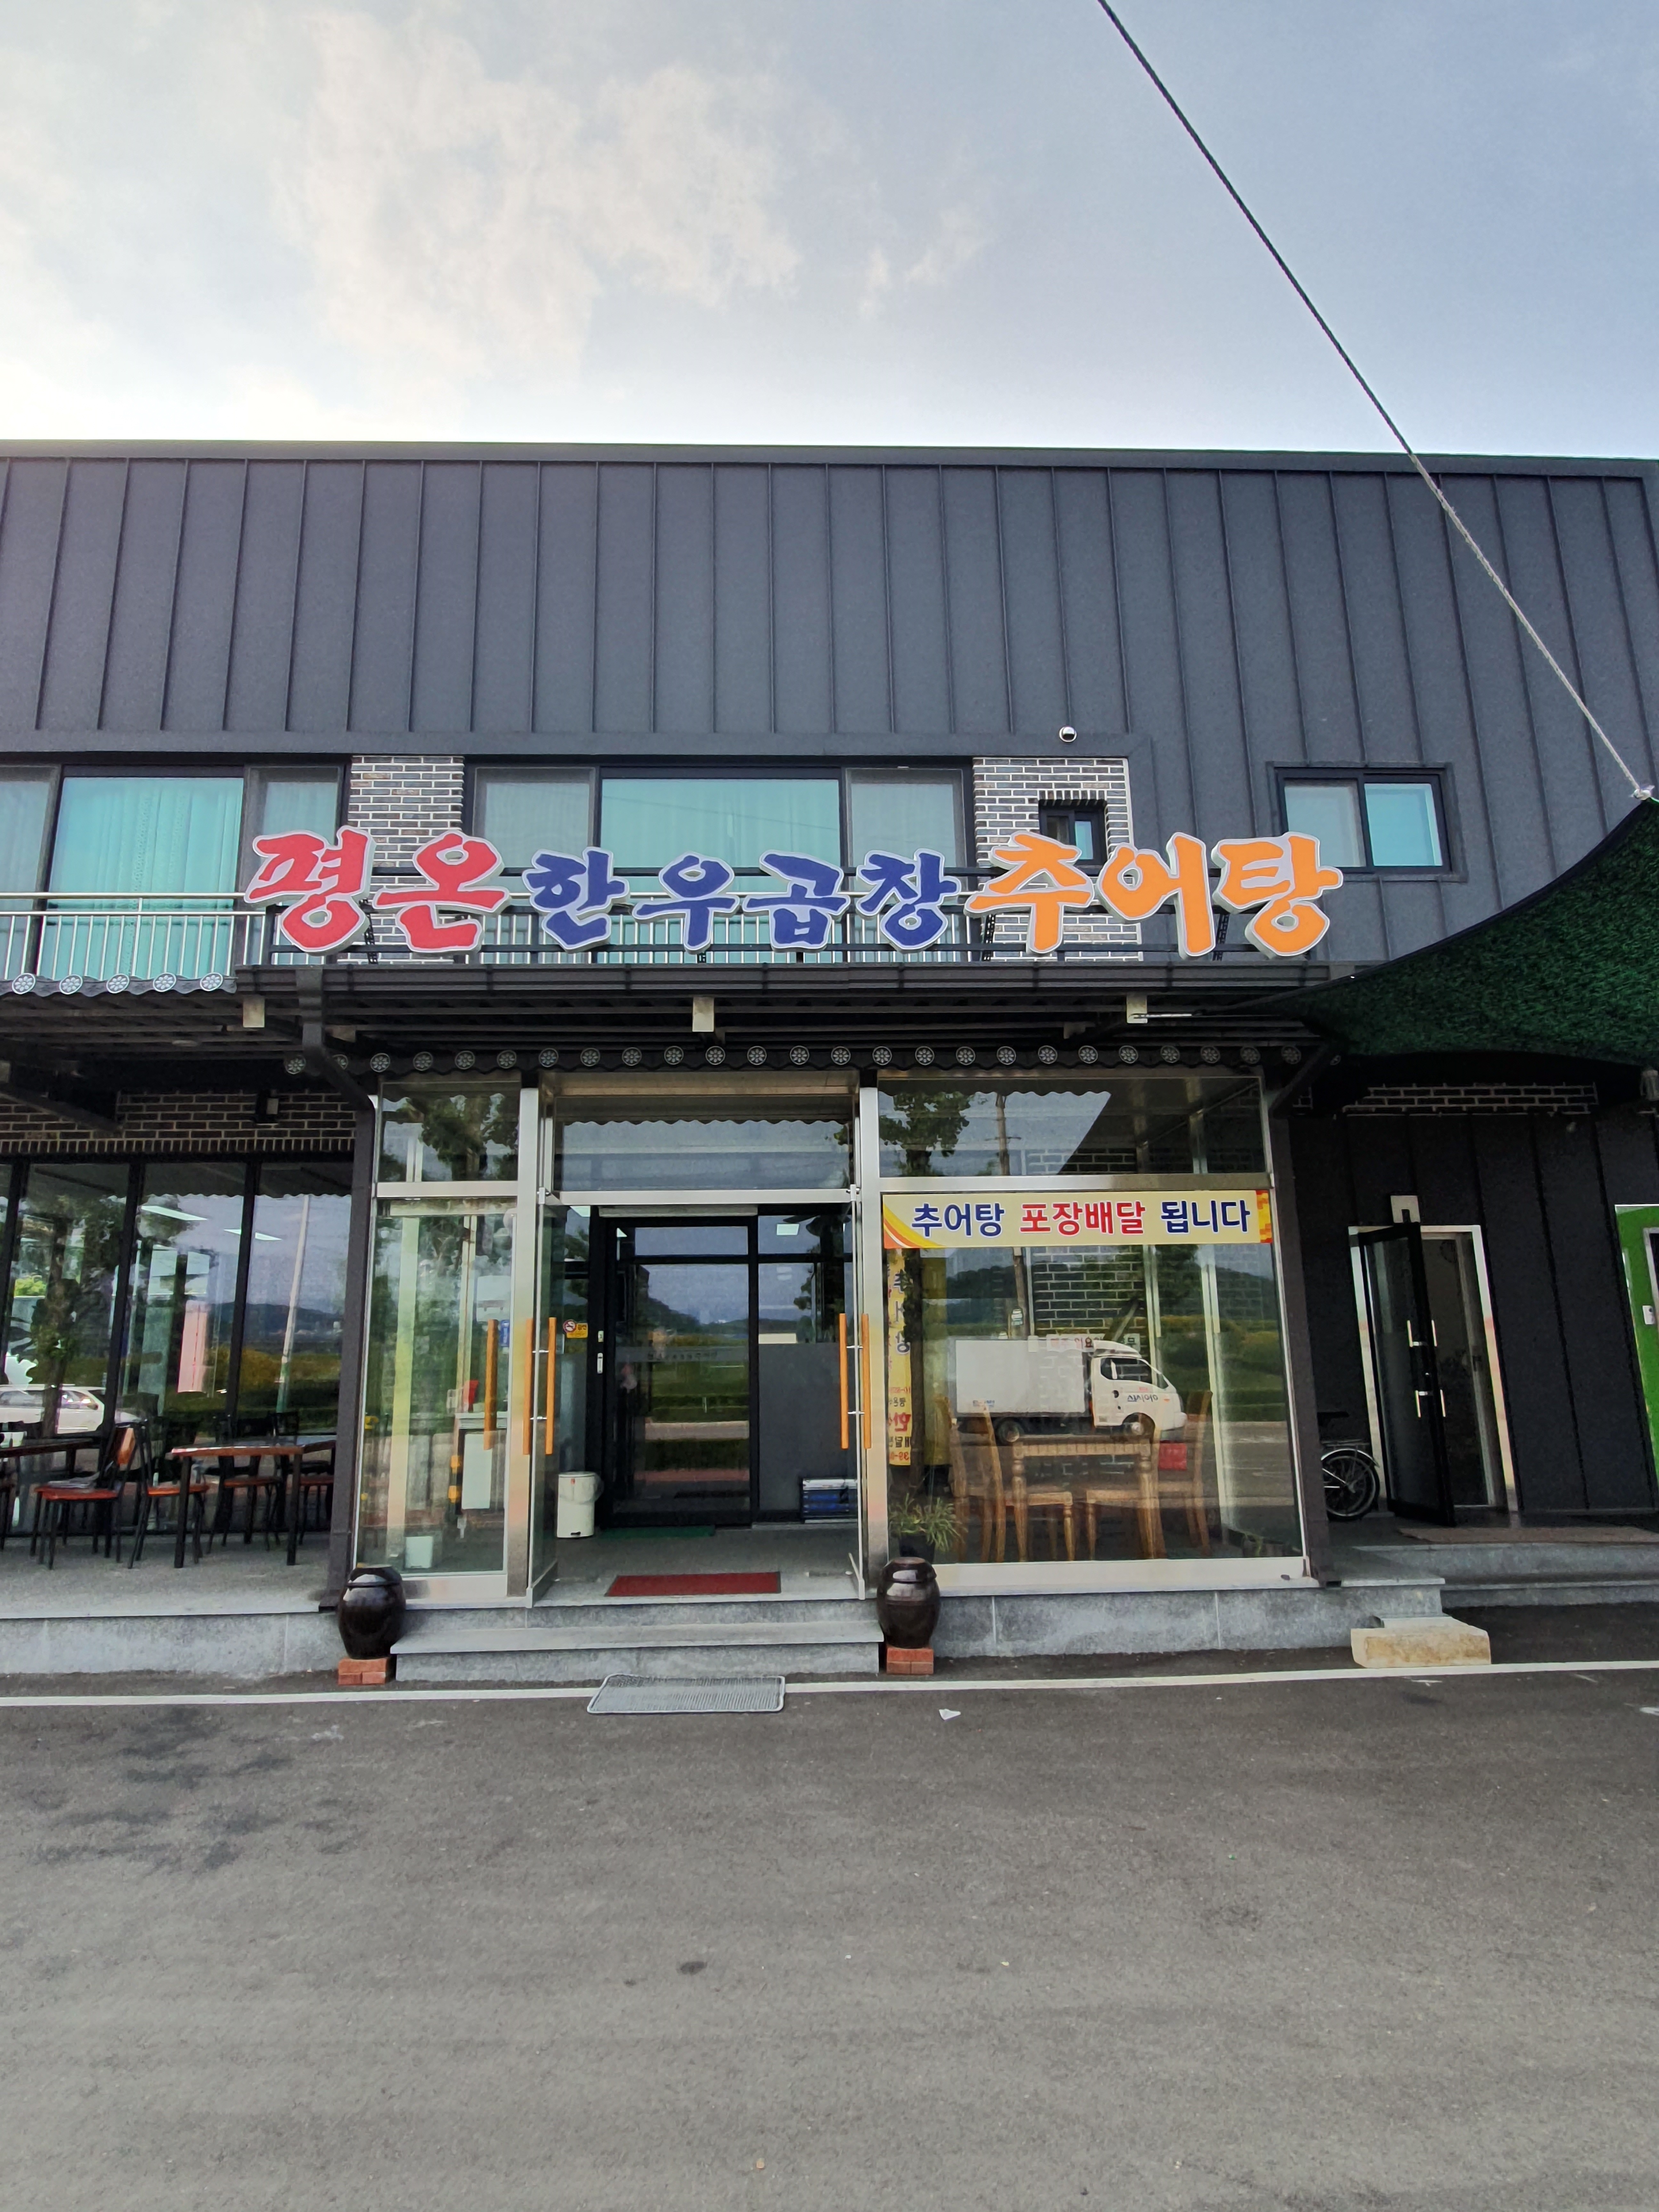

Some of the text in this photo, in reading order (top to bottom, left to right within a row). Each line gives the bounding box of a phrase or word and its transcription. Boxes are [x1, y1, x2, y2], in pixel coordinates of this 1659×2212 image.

[244, 825, 1344, 959] 평온 한우곱창 추어탕
[911, 1199, 1250, 1237] 추어탕 포장배달 됩니다
